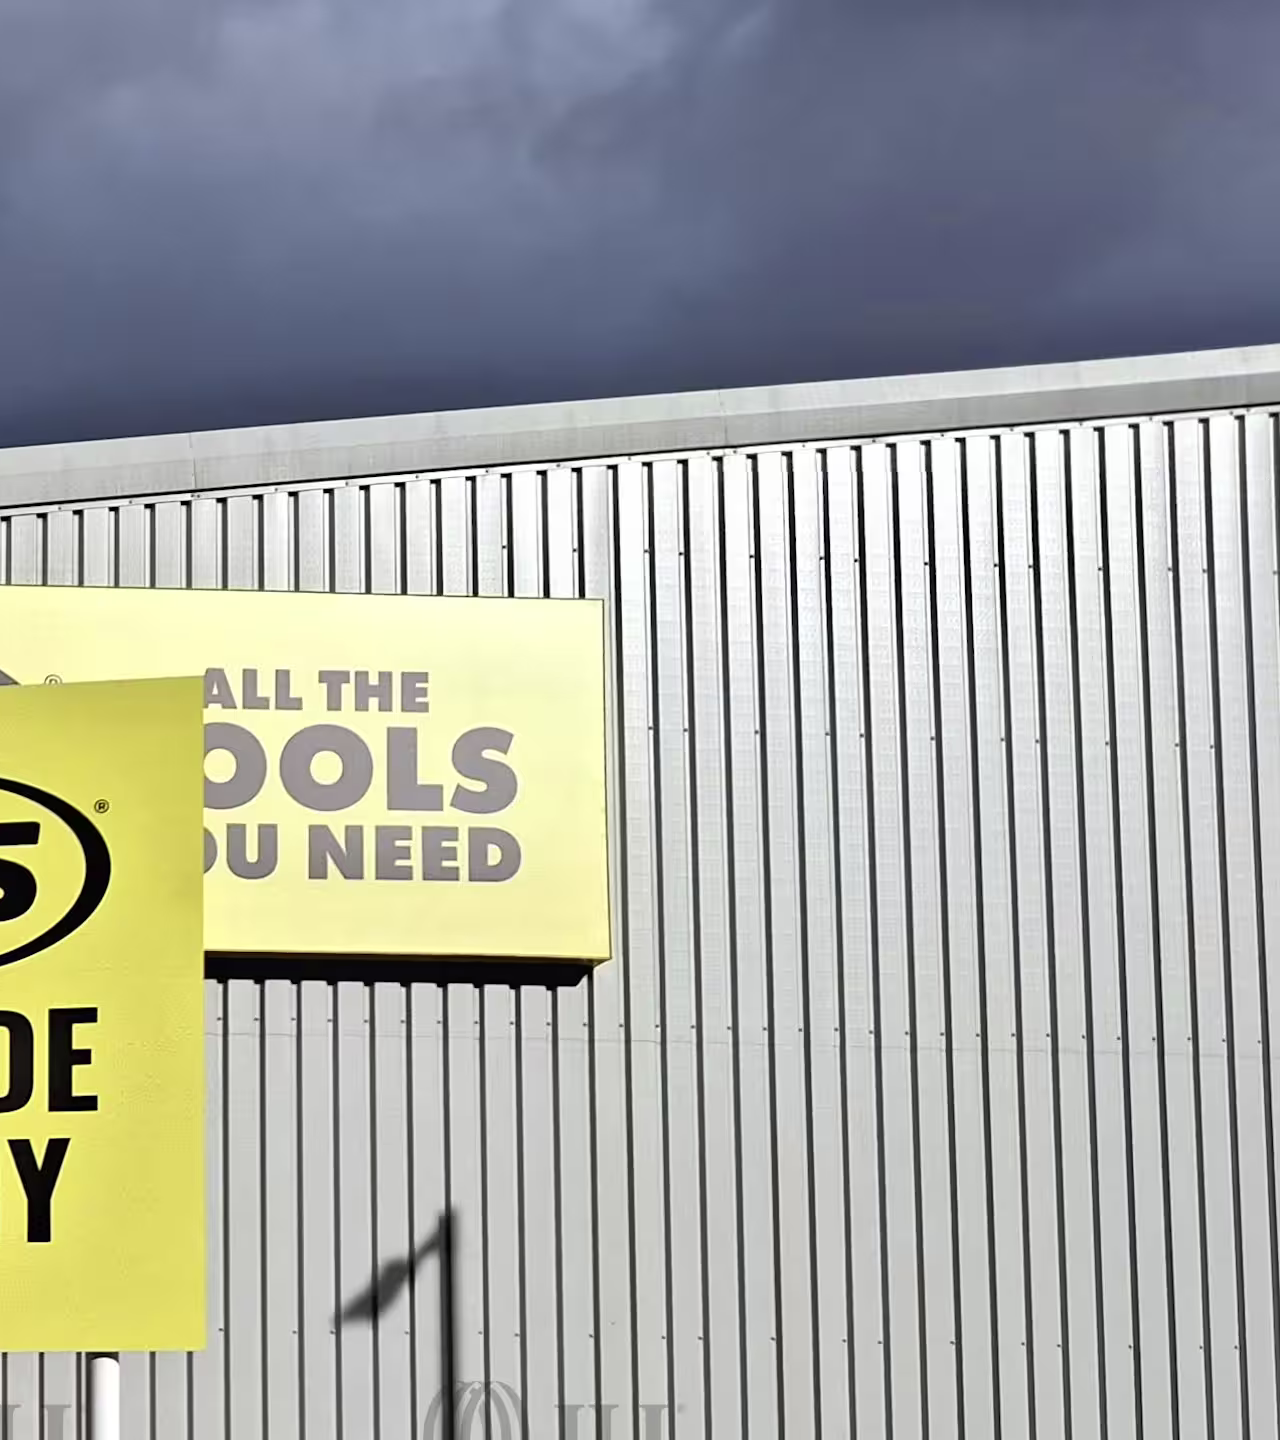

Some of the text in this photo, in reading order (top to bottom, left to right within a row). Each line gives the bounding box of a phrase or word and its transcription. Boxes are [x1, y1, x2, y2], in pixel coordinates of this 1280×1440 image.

[203, 668, 430, 713] ALL THE
[203, 722, 518, 814] OOLS
[308, 824, 522, 883] NEED
